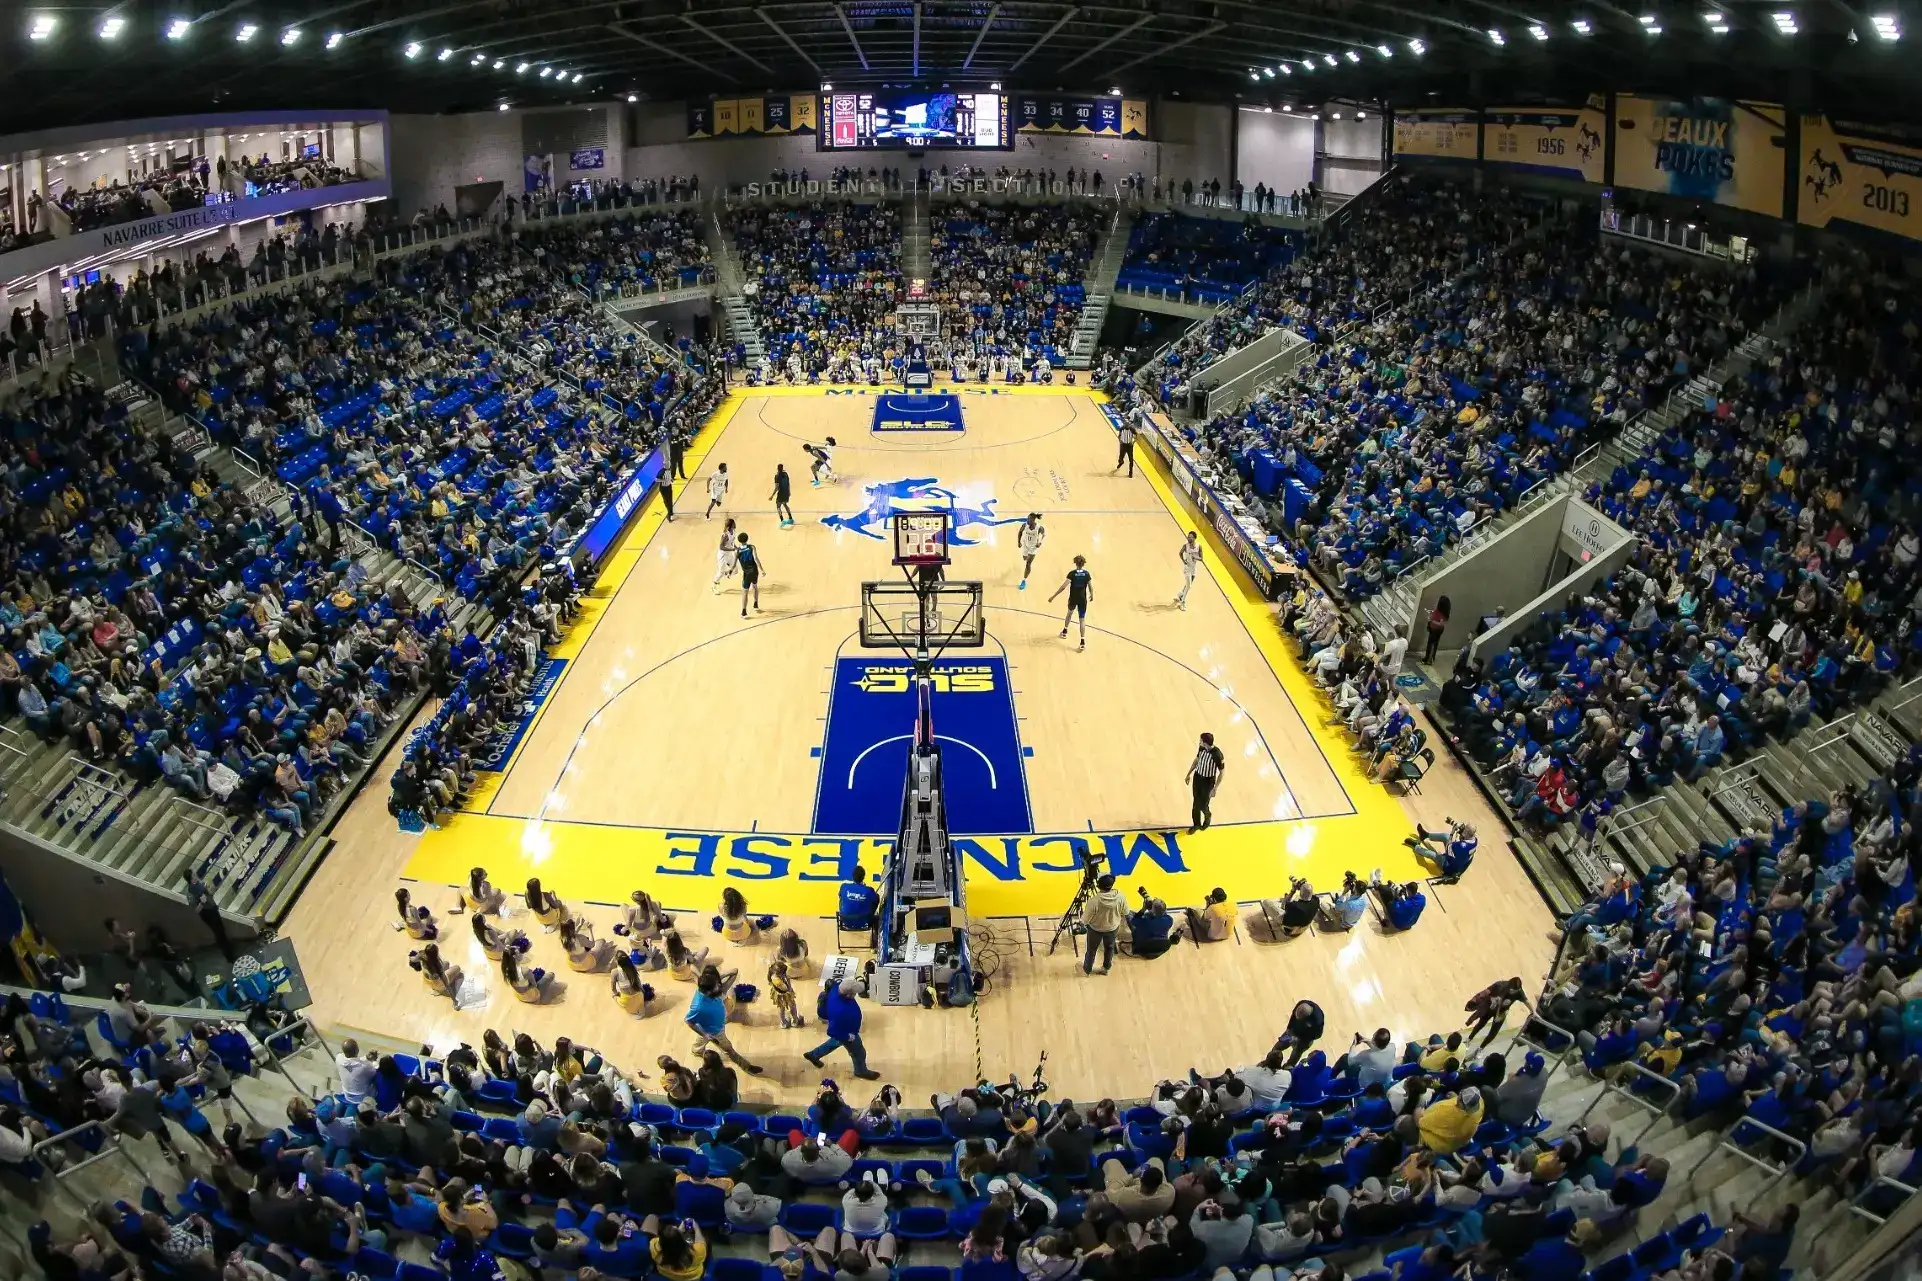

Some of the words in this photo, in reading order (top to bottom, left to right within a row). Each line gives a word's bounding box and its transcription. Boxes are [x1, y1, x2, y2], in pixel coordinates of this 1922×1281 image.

[770, 107, 783, 117] 25
[798, 106, 809, 116] 32
[1023, 105, 1036, 115] 33
[1050, 106, 1062, 116] 34
[1076, 108, 1089, 118] 40
[1102, 109, 1115, 119] 52
[905, 137, 923, 145] 9:00
[1536, 136, 1565, 155] 1956
[1655, 144, 1736, 181] POKES
[749, 178, 880, 196] STUDENT
[952, 177, 1084, 196] SECTION
[1863, 183, 1909, 217] 2013
[103, 219, 165, 247] NAVARRE
[165, 211, 202, 232] SUITE
[907, 533, 935, 554] 26
[1571, 524, 1583, 537] LEE
[1583, 532, 1606, 552] HOFFO
[1243, 556, 1270, 595] JEWELERS
[861, 673, 995, 692] SLC
[487, 720, 521, 762] Ochsner
[1867, 716, 1909, 758] NAVARR
[1736, 777, 1777, 823] NAVARR
[656, 832, 1192, 881] MCNESE
[833, 957, 850, 983] DEFENS
[888, 970, 900, 1003] COWBOYS
